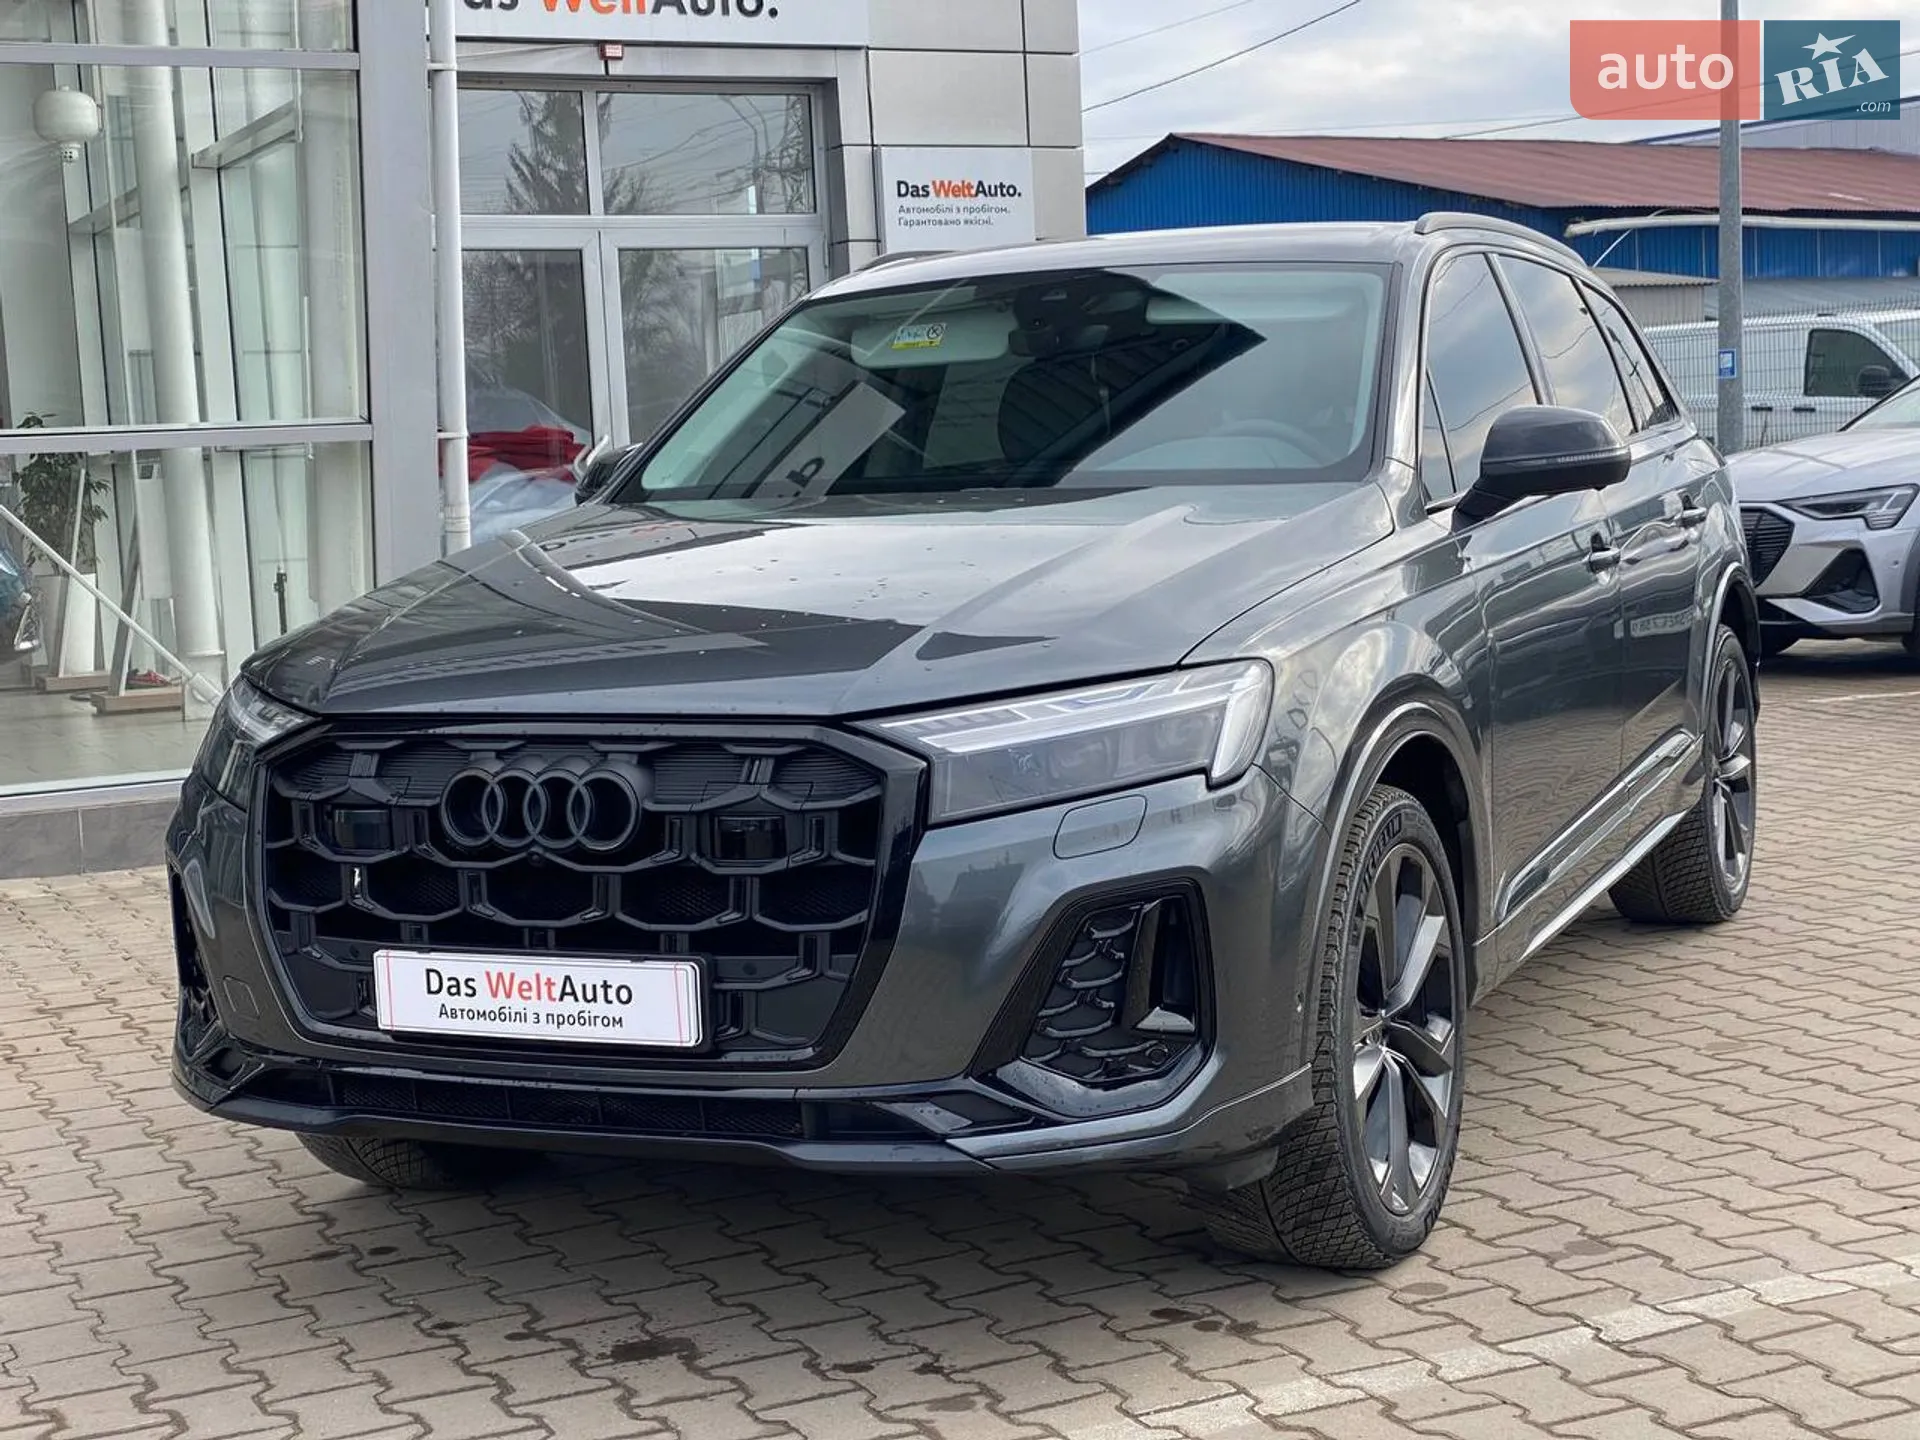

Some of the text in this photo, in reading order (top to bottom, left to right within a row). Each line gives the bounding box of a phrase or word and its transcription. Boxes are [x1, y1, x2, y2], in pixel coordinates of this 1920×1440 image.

[896, 180, 1022, 198] Das WeltAuto.
[898, 205, 953, 214] Автомобілі
[898, 218, 961, 227] Гарантовано
[425, 968, 633, 1005] Das WeltAuto
[438, 1003, 623, 1029] Автомобілі з пробігом
